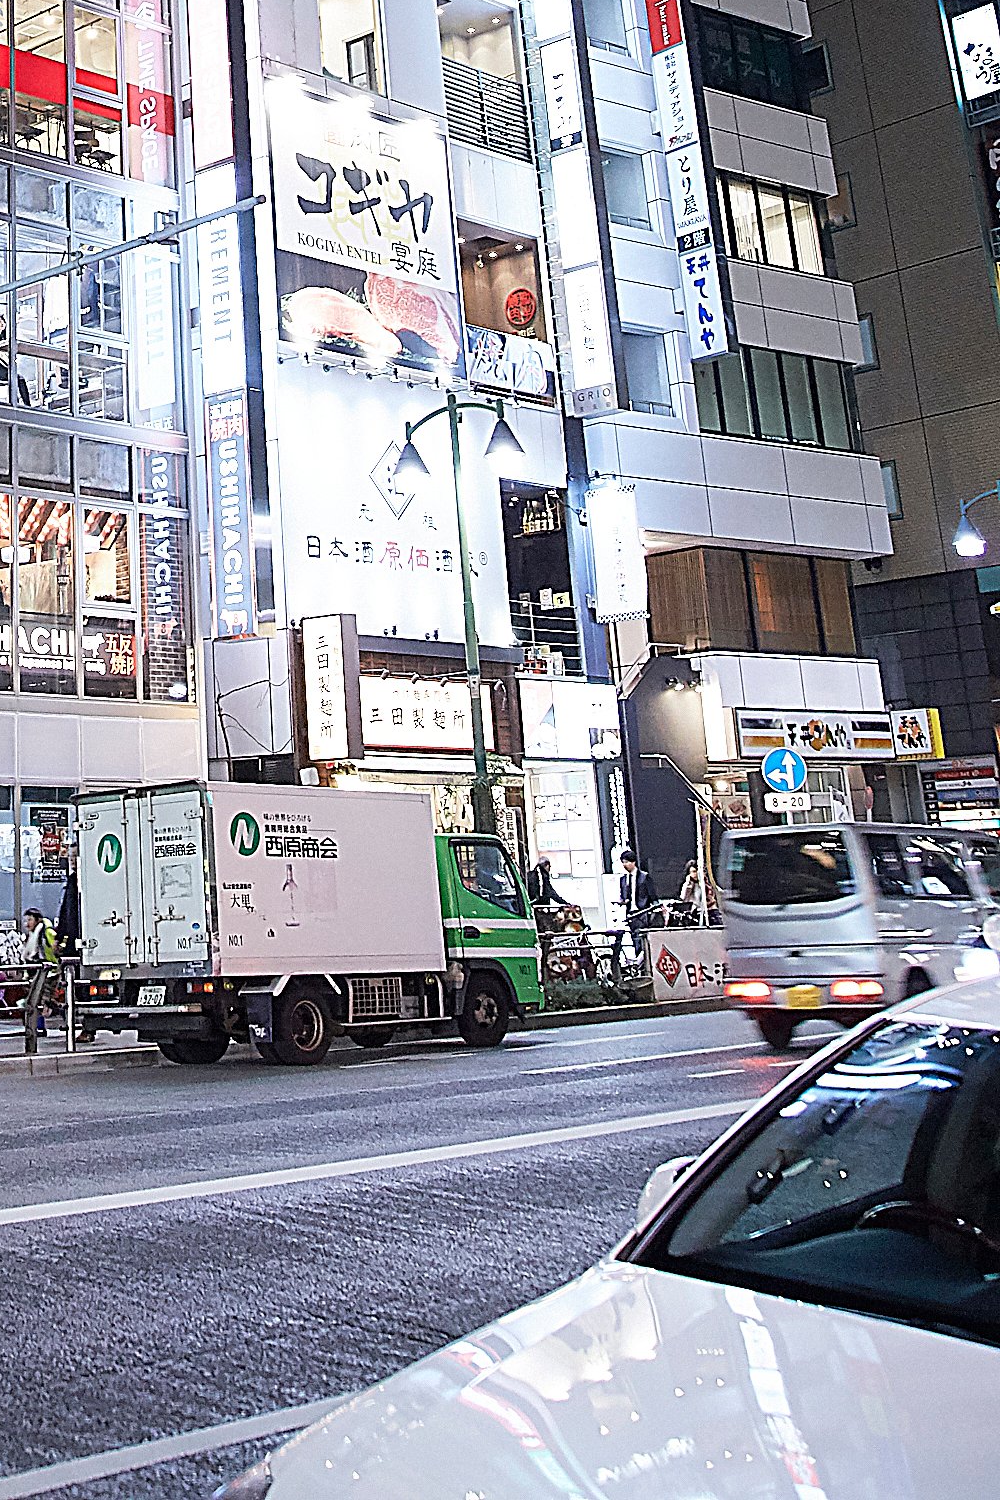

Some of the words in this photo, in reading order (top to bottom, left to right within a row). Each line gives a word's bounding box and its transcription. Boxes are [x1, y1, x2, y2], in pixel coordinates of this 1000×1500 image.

[295, 152, 434, 243] コギヤ
[677, 155, 699, 217] とり屋
[296, 232, 345, 258] KOGIYA
[347, 244, 382, 265] ENTEI
[683, 229, 706, 249] 2階
[389, 241, 442, 281] 宴庭
[693, 276, 716, 351] てんや
[577, 386, 612, 403] GRIO
[217, 439, 241, 608] USHIHACHI
[315, 635, 334, 739] 三田製麺所
[369, 707, 466, 731] 三田製麺所
[772, 796, 804, 808] 8-20
[154, 842, 197, 859] 西原商会
[264, 835, 338, 859] 西原商会
[228, 934, 243, 947] NO.1
